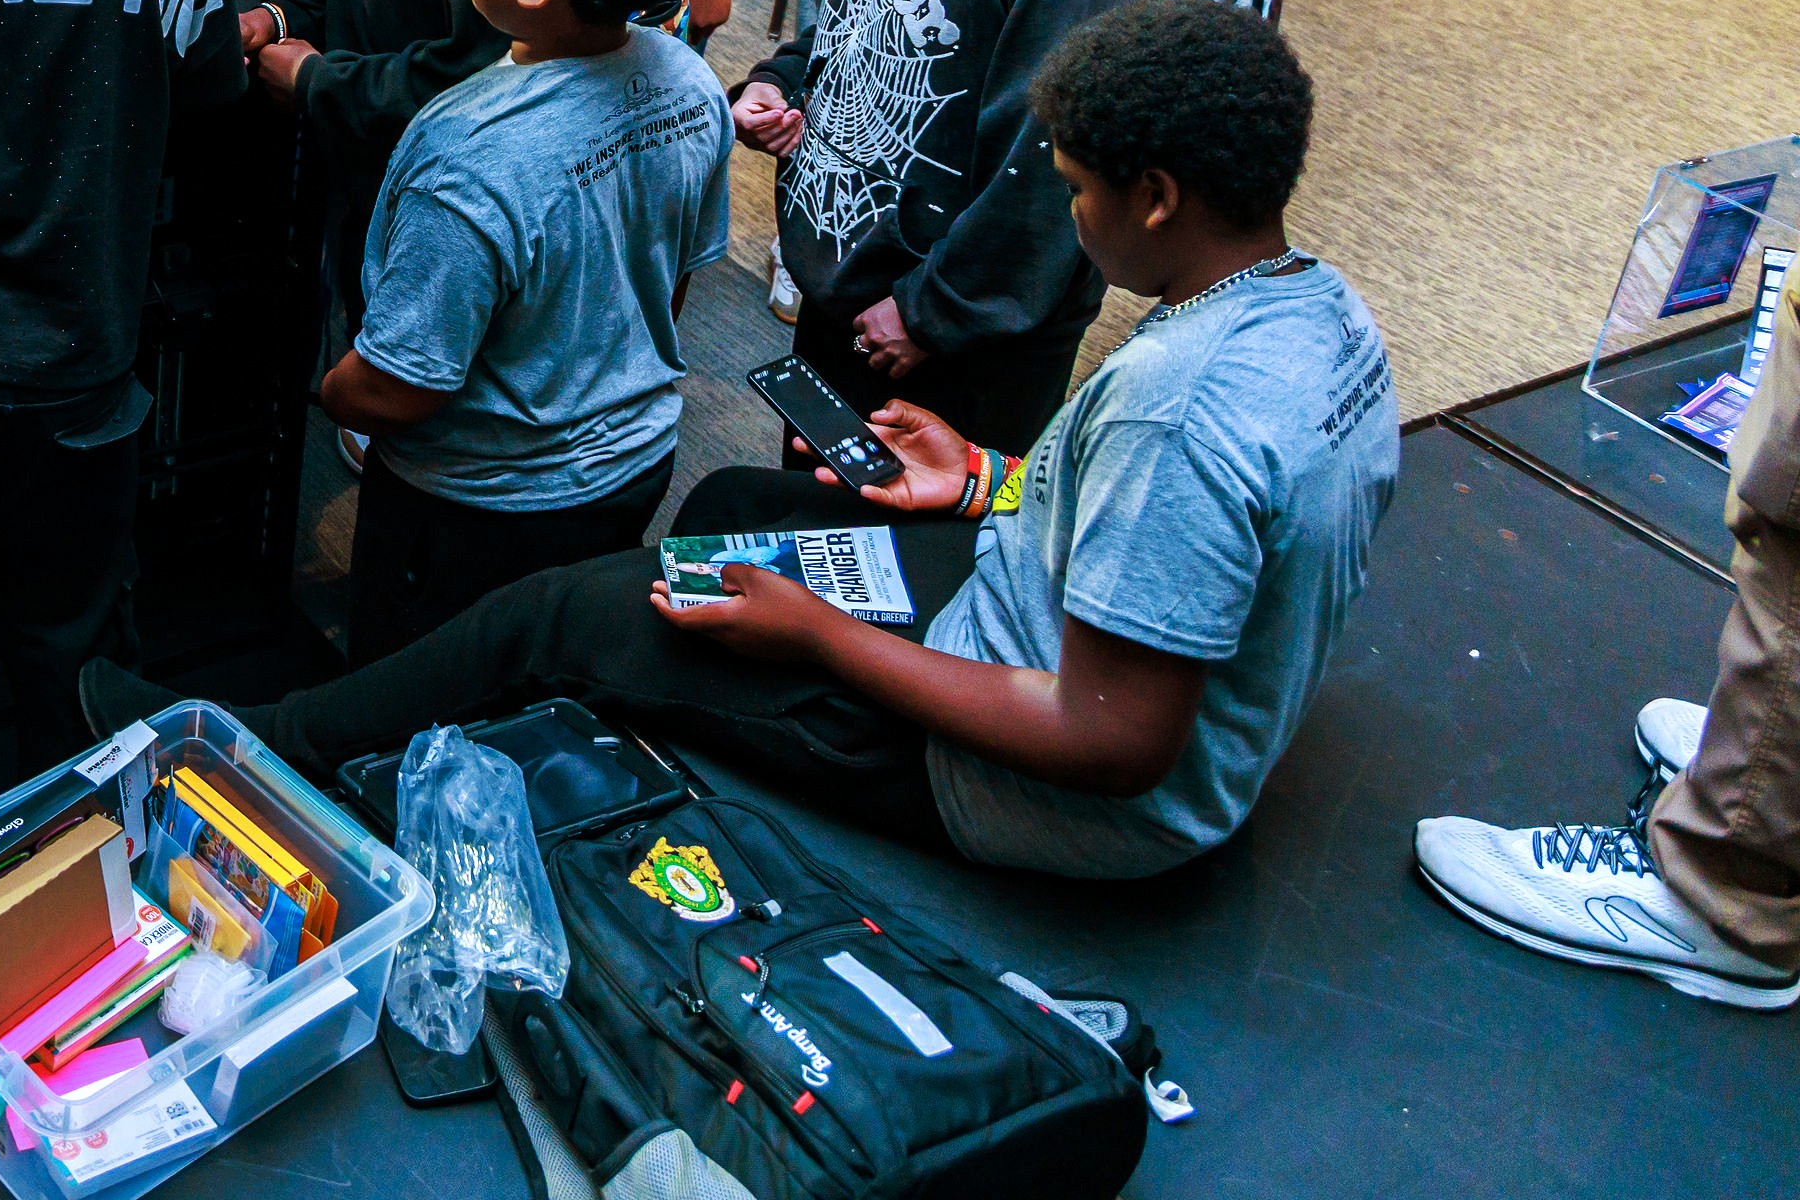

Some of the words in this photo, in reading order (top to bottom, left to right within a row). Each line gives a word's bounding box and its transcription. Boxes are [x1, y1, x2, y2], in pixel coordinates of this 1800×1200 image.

[640, 115, 678, 139] YOUNG
[797, 535, 837, 594] MENTALITY
[826, 532, 871, 603] CHANGER
[853, 610, 872, 621] KYLE
[881, 612, 909, 623] GREENE
[0, 817, 25, 838] Glow
[150, 922, 175, 939] INDEX
